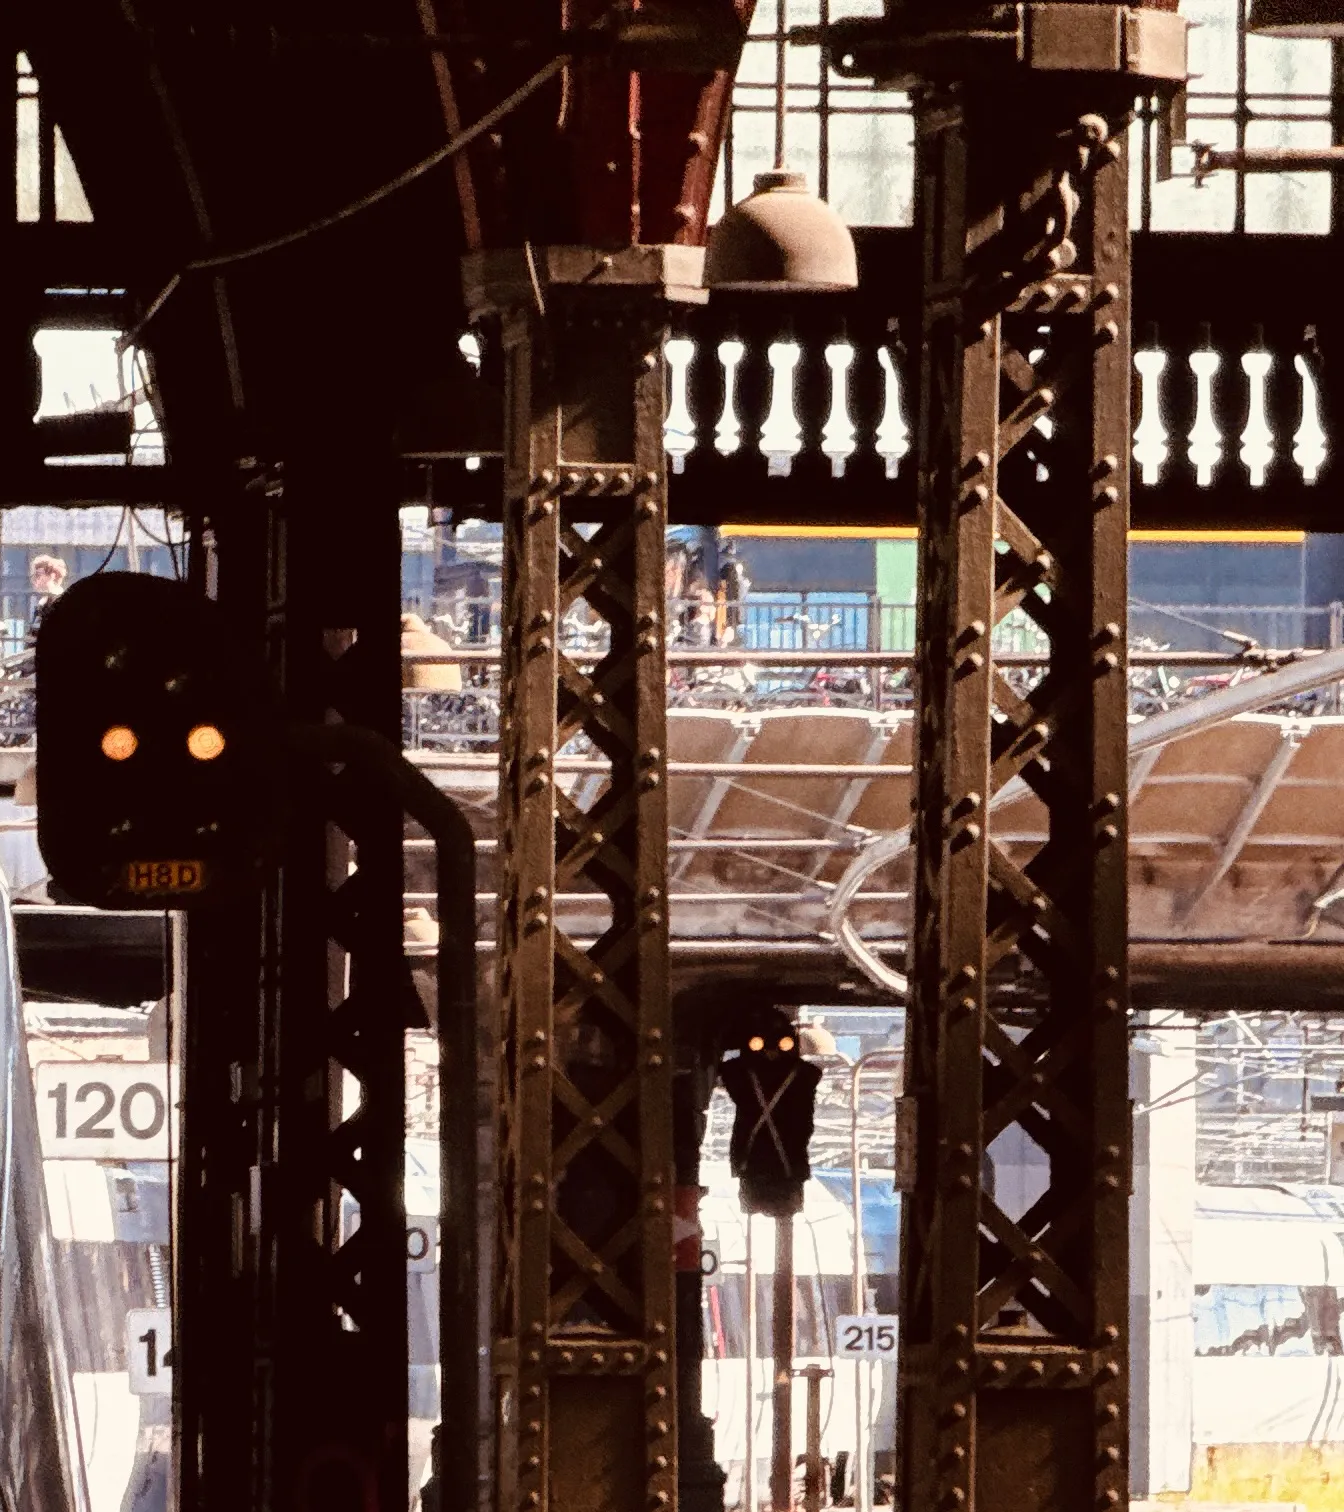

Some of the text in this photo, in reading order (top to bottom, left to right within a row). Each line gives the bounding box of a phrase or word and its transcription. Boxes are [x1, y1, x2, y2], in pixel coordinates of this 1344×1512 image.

[135, 864, 197, 886] H8D
[48, 1082, 165, 1139] 120
[139, 1329, 173, 1376] 1
[843, 1325, 895, 1351] 215
